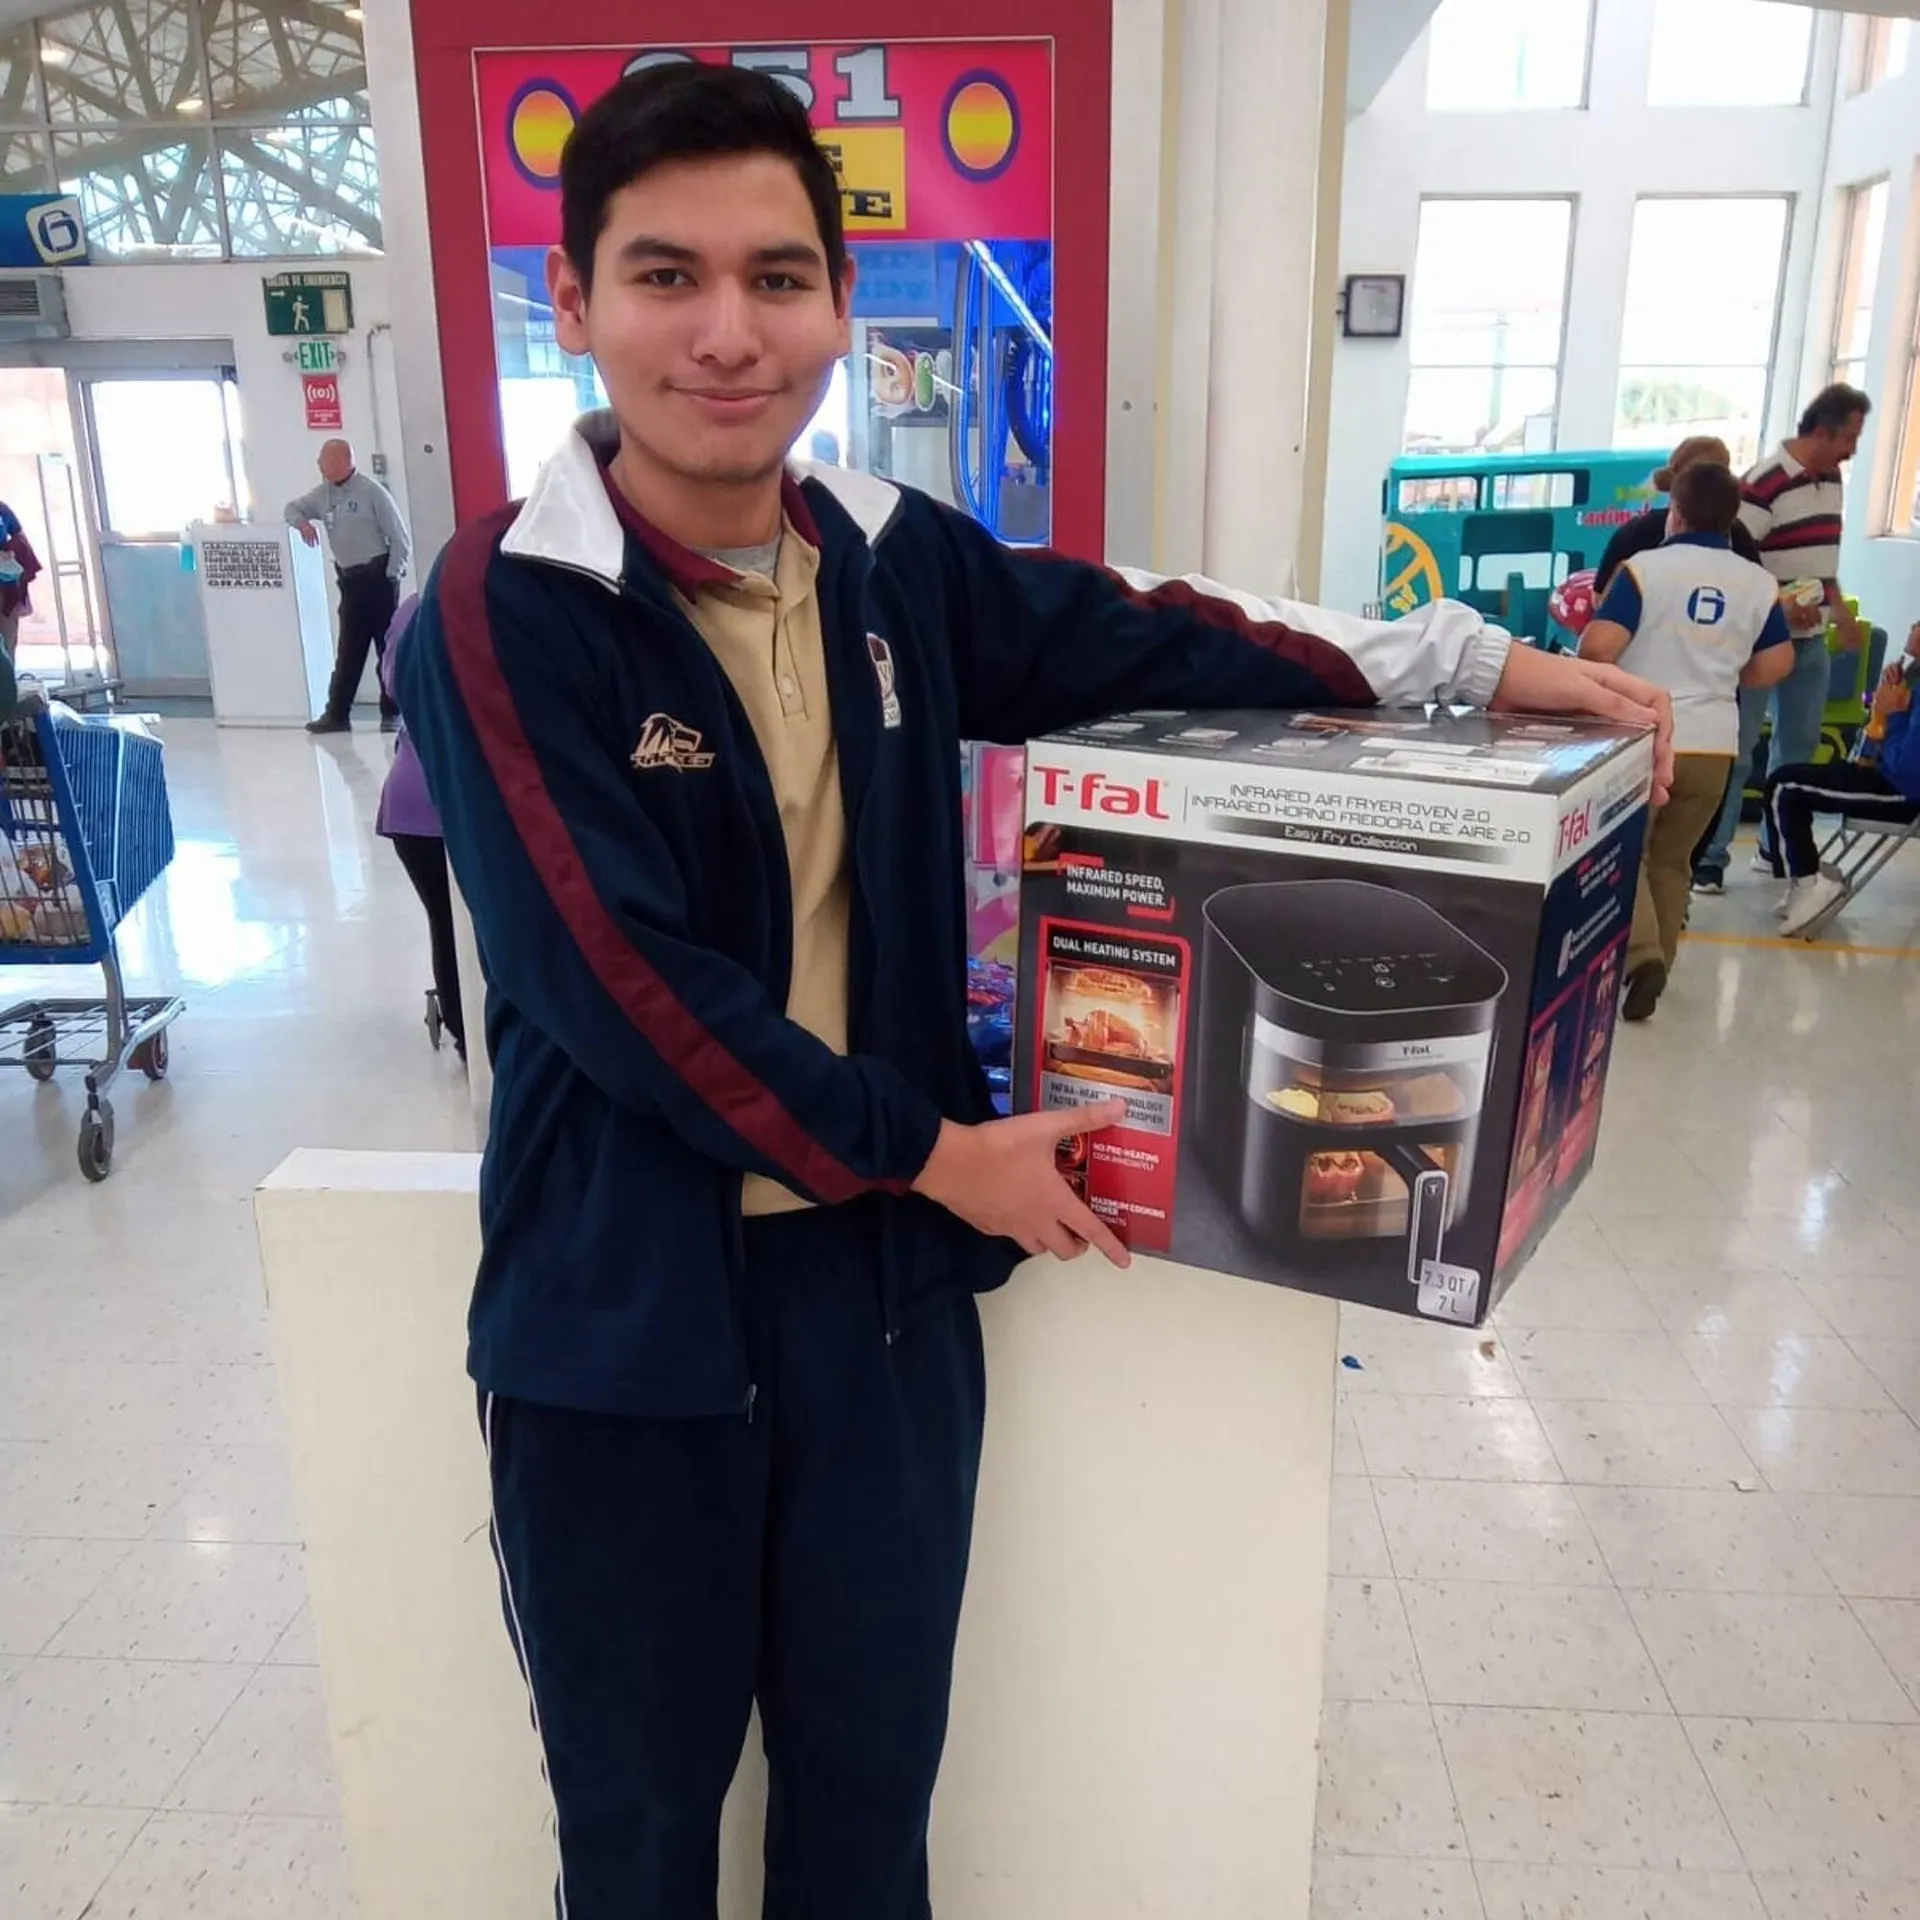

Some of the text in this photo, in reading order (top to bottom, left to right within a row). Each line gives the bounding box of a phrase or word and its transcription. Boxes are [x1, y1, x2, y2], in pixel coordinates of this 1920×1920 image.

[620, 44, 900, 121] 51
[299, 342, 331, 370] EXIT
[207, 579, 283, 588] GRACIAS
[1033, 765, 1169, 821] T-fal
[1230, 784, 1490, 823] INFRARED AIR FRYER OVEN 2.0
[1191, 795, 1271, 814] INFRARED
[1275, 804, 1335, 822] HORNO
[1429, 821, 1454, 835] DE
[1458, 824, 1498, 841] AIRE
[1502, 829, 1531, 844] 2.0
[1558, 799, 1591, 858] T-fal
[1284, 826, 1418, 852] Easy Fry Collection
[1066, 864, 1123, 884] INFRARED
[1066, 881, 1120, 900] MAXIMUM
[1053, 935, 1176, 967] DUAL HEATING SYSTEM
[1424, 1271, 1445, 1289] 7.3
